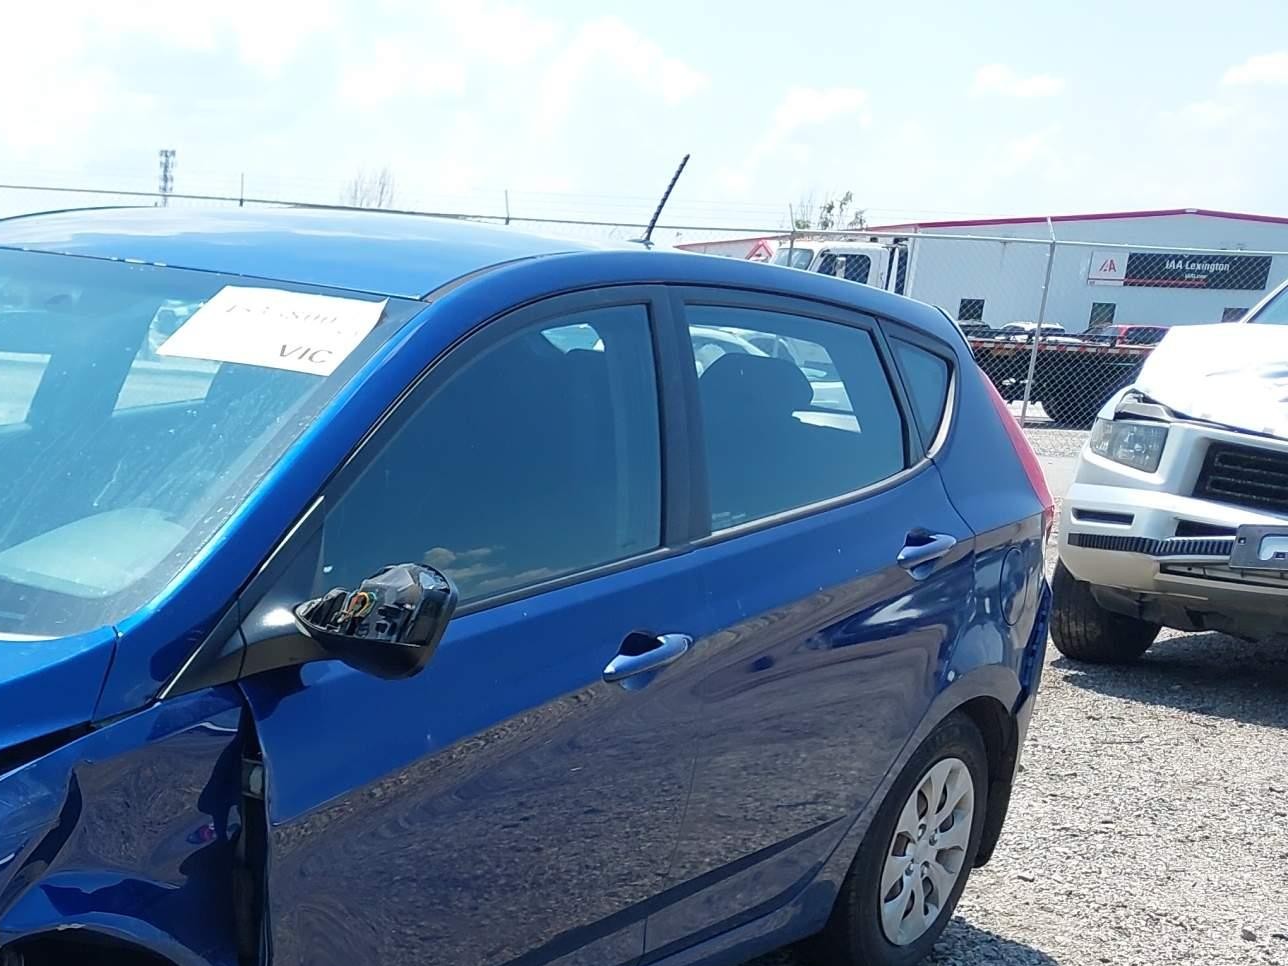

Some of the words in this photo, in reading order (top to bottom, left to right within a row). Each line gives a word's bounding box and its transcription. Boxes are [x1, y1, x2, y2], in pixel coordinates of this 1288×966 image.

[1165, 259, 1183, 270] IAA
[1185, 260, 1230, 273] Lexington
[279, 344, 333, 364] VIC
